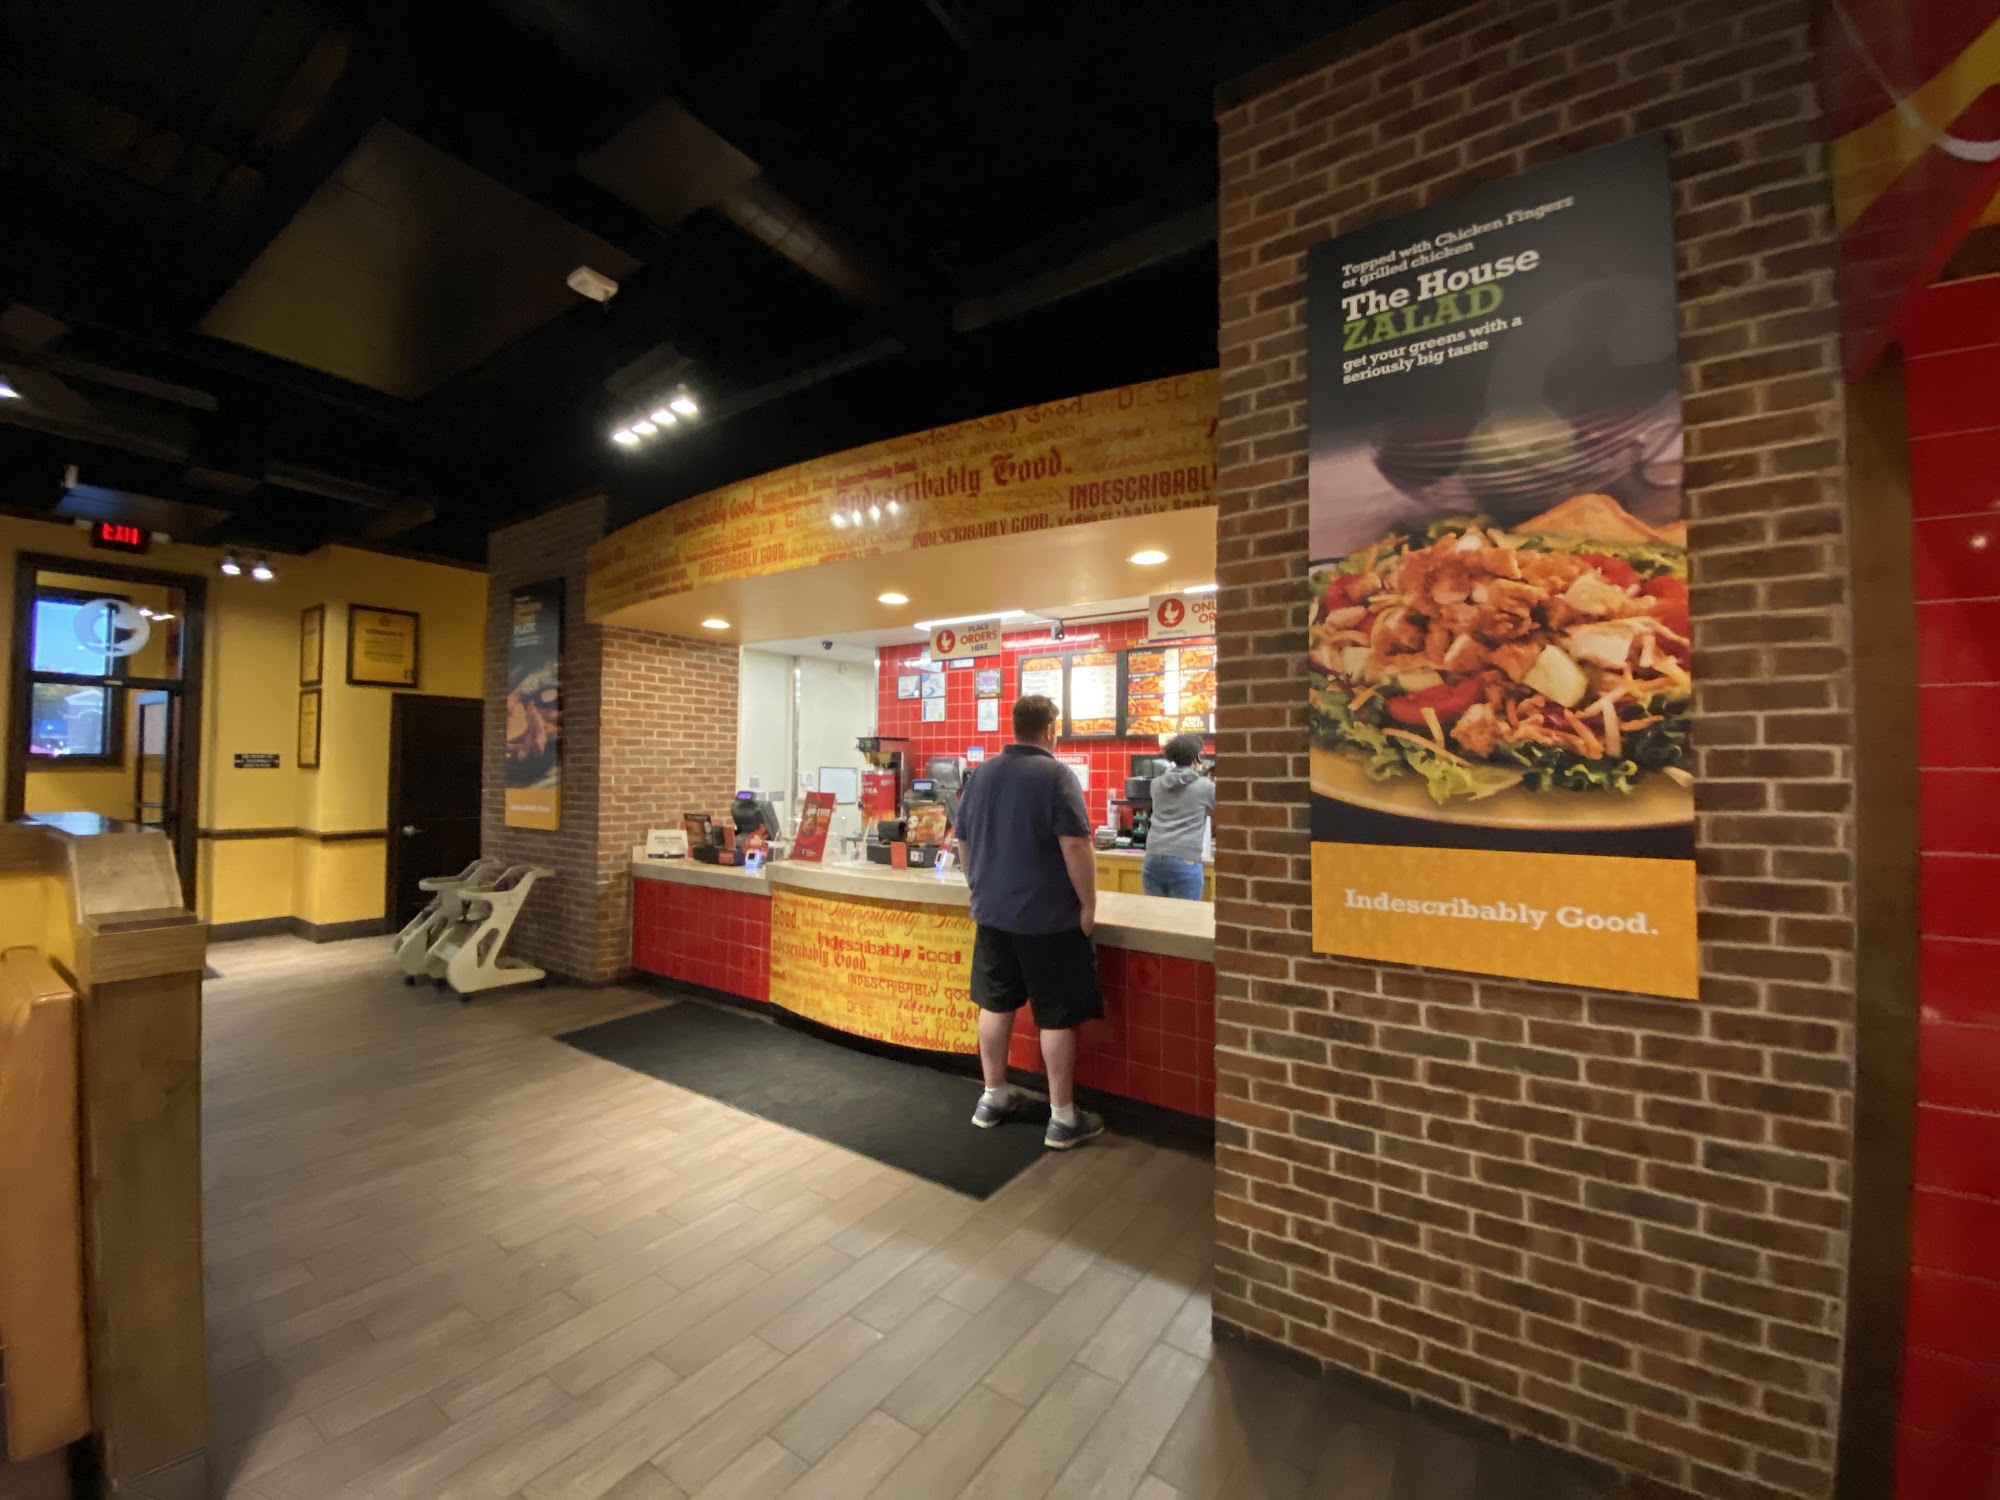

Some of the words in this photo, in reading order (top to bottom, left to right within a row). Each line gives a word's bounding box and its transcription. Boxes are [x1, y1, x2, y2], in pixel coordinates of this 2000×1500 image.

[1342, 251, 1396, 277] Topped
[1398, 240, 1432, 259] with
[1435, 219, 1503, 247] Chicken
[1342, 278, 1357, 290] or
[1360, 261, 1408, 288] grilled
[1411, 241, 1475, 269] chicken
[1342, 287, 1410, 322] The
[1417, 249, 1541, 302] House
[1343, 282, 1504, 352] ZALAD
[1343, 356, 1368, 374] get
[1370, 345, 1406, 367] your
[1408, 332, 1466, 357] greens
[1469, 317, 1508, 338] with
[1511, 316, 1523, 328] a
[1343, 358, 1414, 385] seriously
[1417, 349, 1444, 367] big
[1448, 339, 1489, 358] taste
[1069, 462, 1217, 511] INDESCRIBABL
[102, 522, 139, 545] EXIT
[960, 629, 998, 646] ORDERS
[967, 622, 989, 633] PLACE
[971, 642, 989, 652] HERE
[1343, 887, 1549, 931] Indescribably
[1556, 904, 1660, 936] Good.
